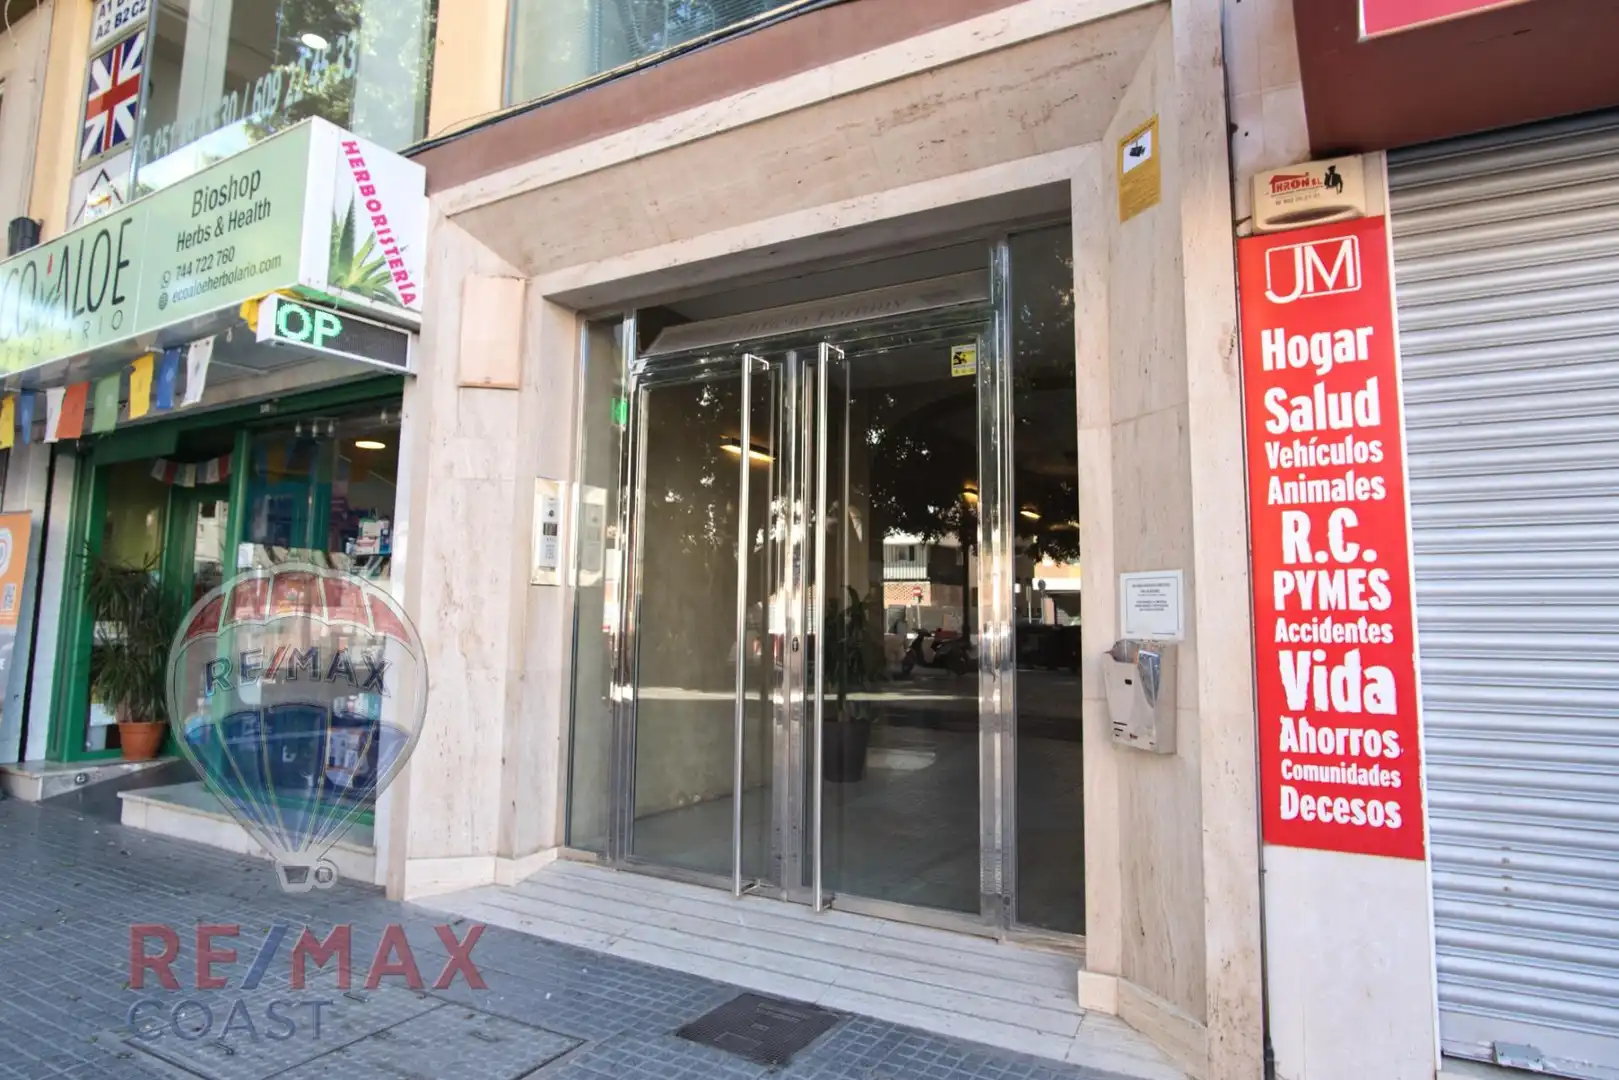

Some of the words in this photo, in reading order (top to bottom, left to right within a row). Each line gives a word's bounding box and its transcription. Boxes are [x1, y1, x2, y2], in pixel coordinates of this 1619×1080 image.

[114, 7, 130, 29] B2
[191, 169, 261, 218] Bioshop
[176, 224, 211, 253] Herbs
[214, 215, 225, 238] &
[227, 197, 272, 232] Health
[172, 255, 282, 303] ecoaloeherbolario.com
[195, 254, 214, 274] 722
[216, 245, 236, 267] 760
[1264, 237, 1358, 304] JM
[277, 303, 343, 347] OP
[1261, 326, 1373, 376] Hogar
[1263, 376, 1381, 435] Salud
[1264, 434, 1384, 469] Vehículos
[1267, 470, 1386, 505] Animales
[1281, 507, 1378, 564] R.C.
[1273, 568, 1392, 611] PYMES
[1275, 616, 1394, 644] Accidentes
[1278, 648, 1397, 715] Vida
[1279, 715, 1401, 759] Ahorros
[1281, 759, 1401, 788] Comunidades
[1279, 785, 1401, 829] Decesos
